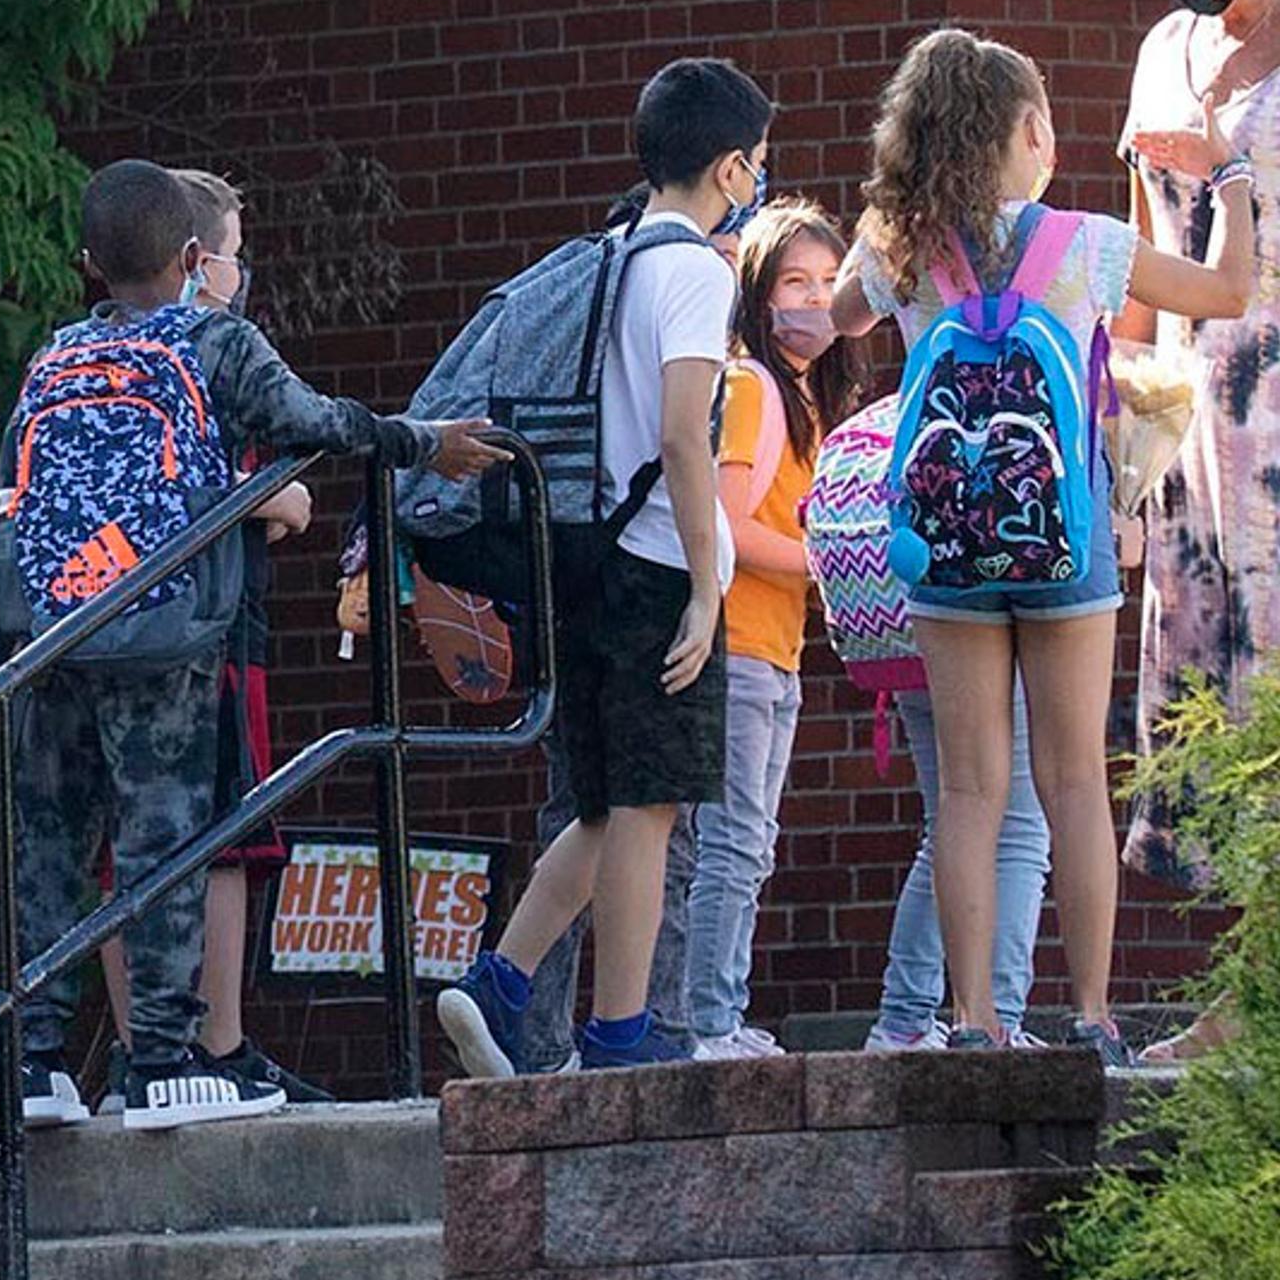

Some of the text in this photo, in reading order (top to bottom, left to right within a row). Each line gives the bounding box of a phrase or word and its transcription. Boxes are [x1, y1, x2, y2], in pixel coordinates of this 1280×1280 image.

[280, 863, 490, 926] HERES
[274, 920, 479, 963] WORK ERE!
